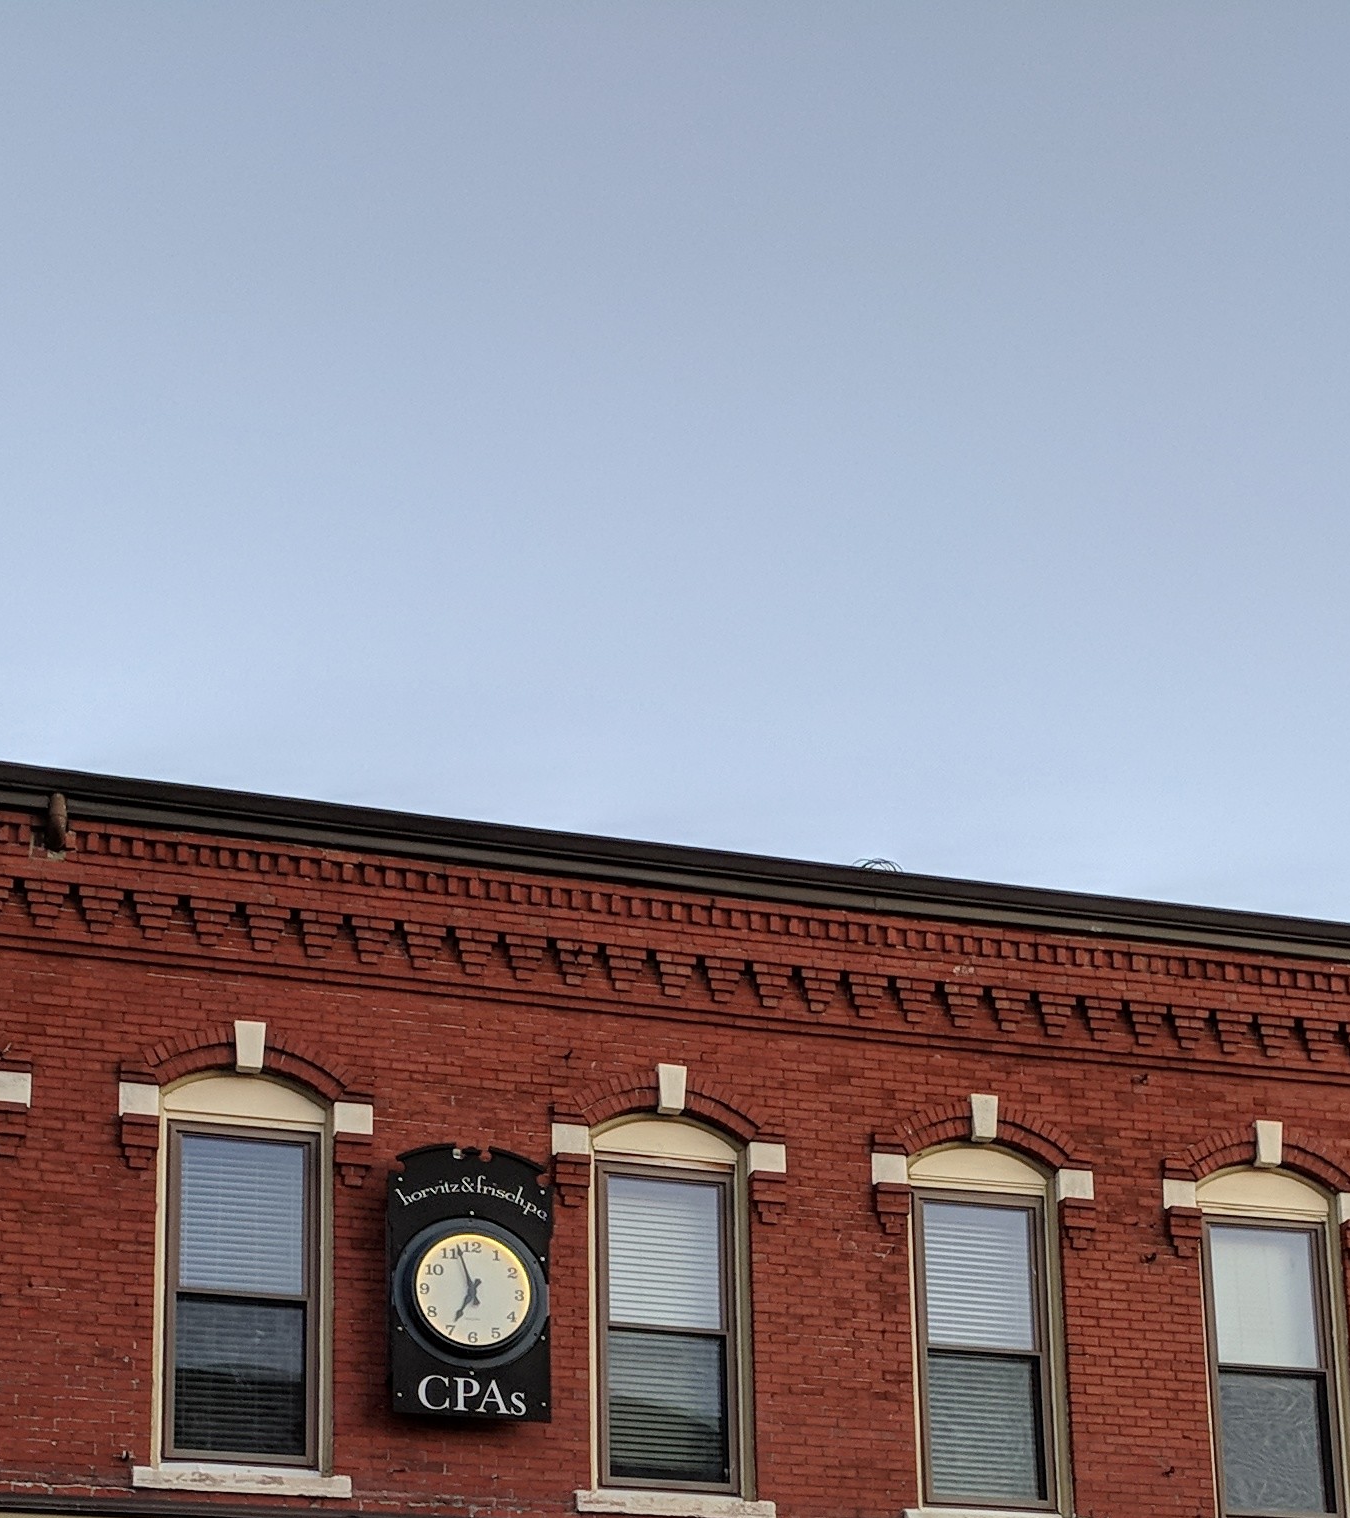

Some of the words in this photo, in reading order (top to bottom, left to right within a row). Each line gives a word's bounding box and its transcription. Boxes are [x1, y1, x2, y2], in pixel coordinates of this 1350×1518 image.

[463, 1241, 481, 1254] 12
[492, 1250, 501, 1262] 1
[425, 1264, 444, 1276] 10
[507, 1267, 518, 1279] 2
[419, 1283, 430, 1295] 9
[514, 1290, 525, 1302] 3
[426, 1305, 438, 1318] 8
[506, 1311, 517, 1323] 4
[445, 1324, 456, 1336] 7
[490, 1327, 501, 1339] 5
[467, 1331, 478, 1344] 6
[417, 1374, 528, 1417] CPAs
